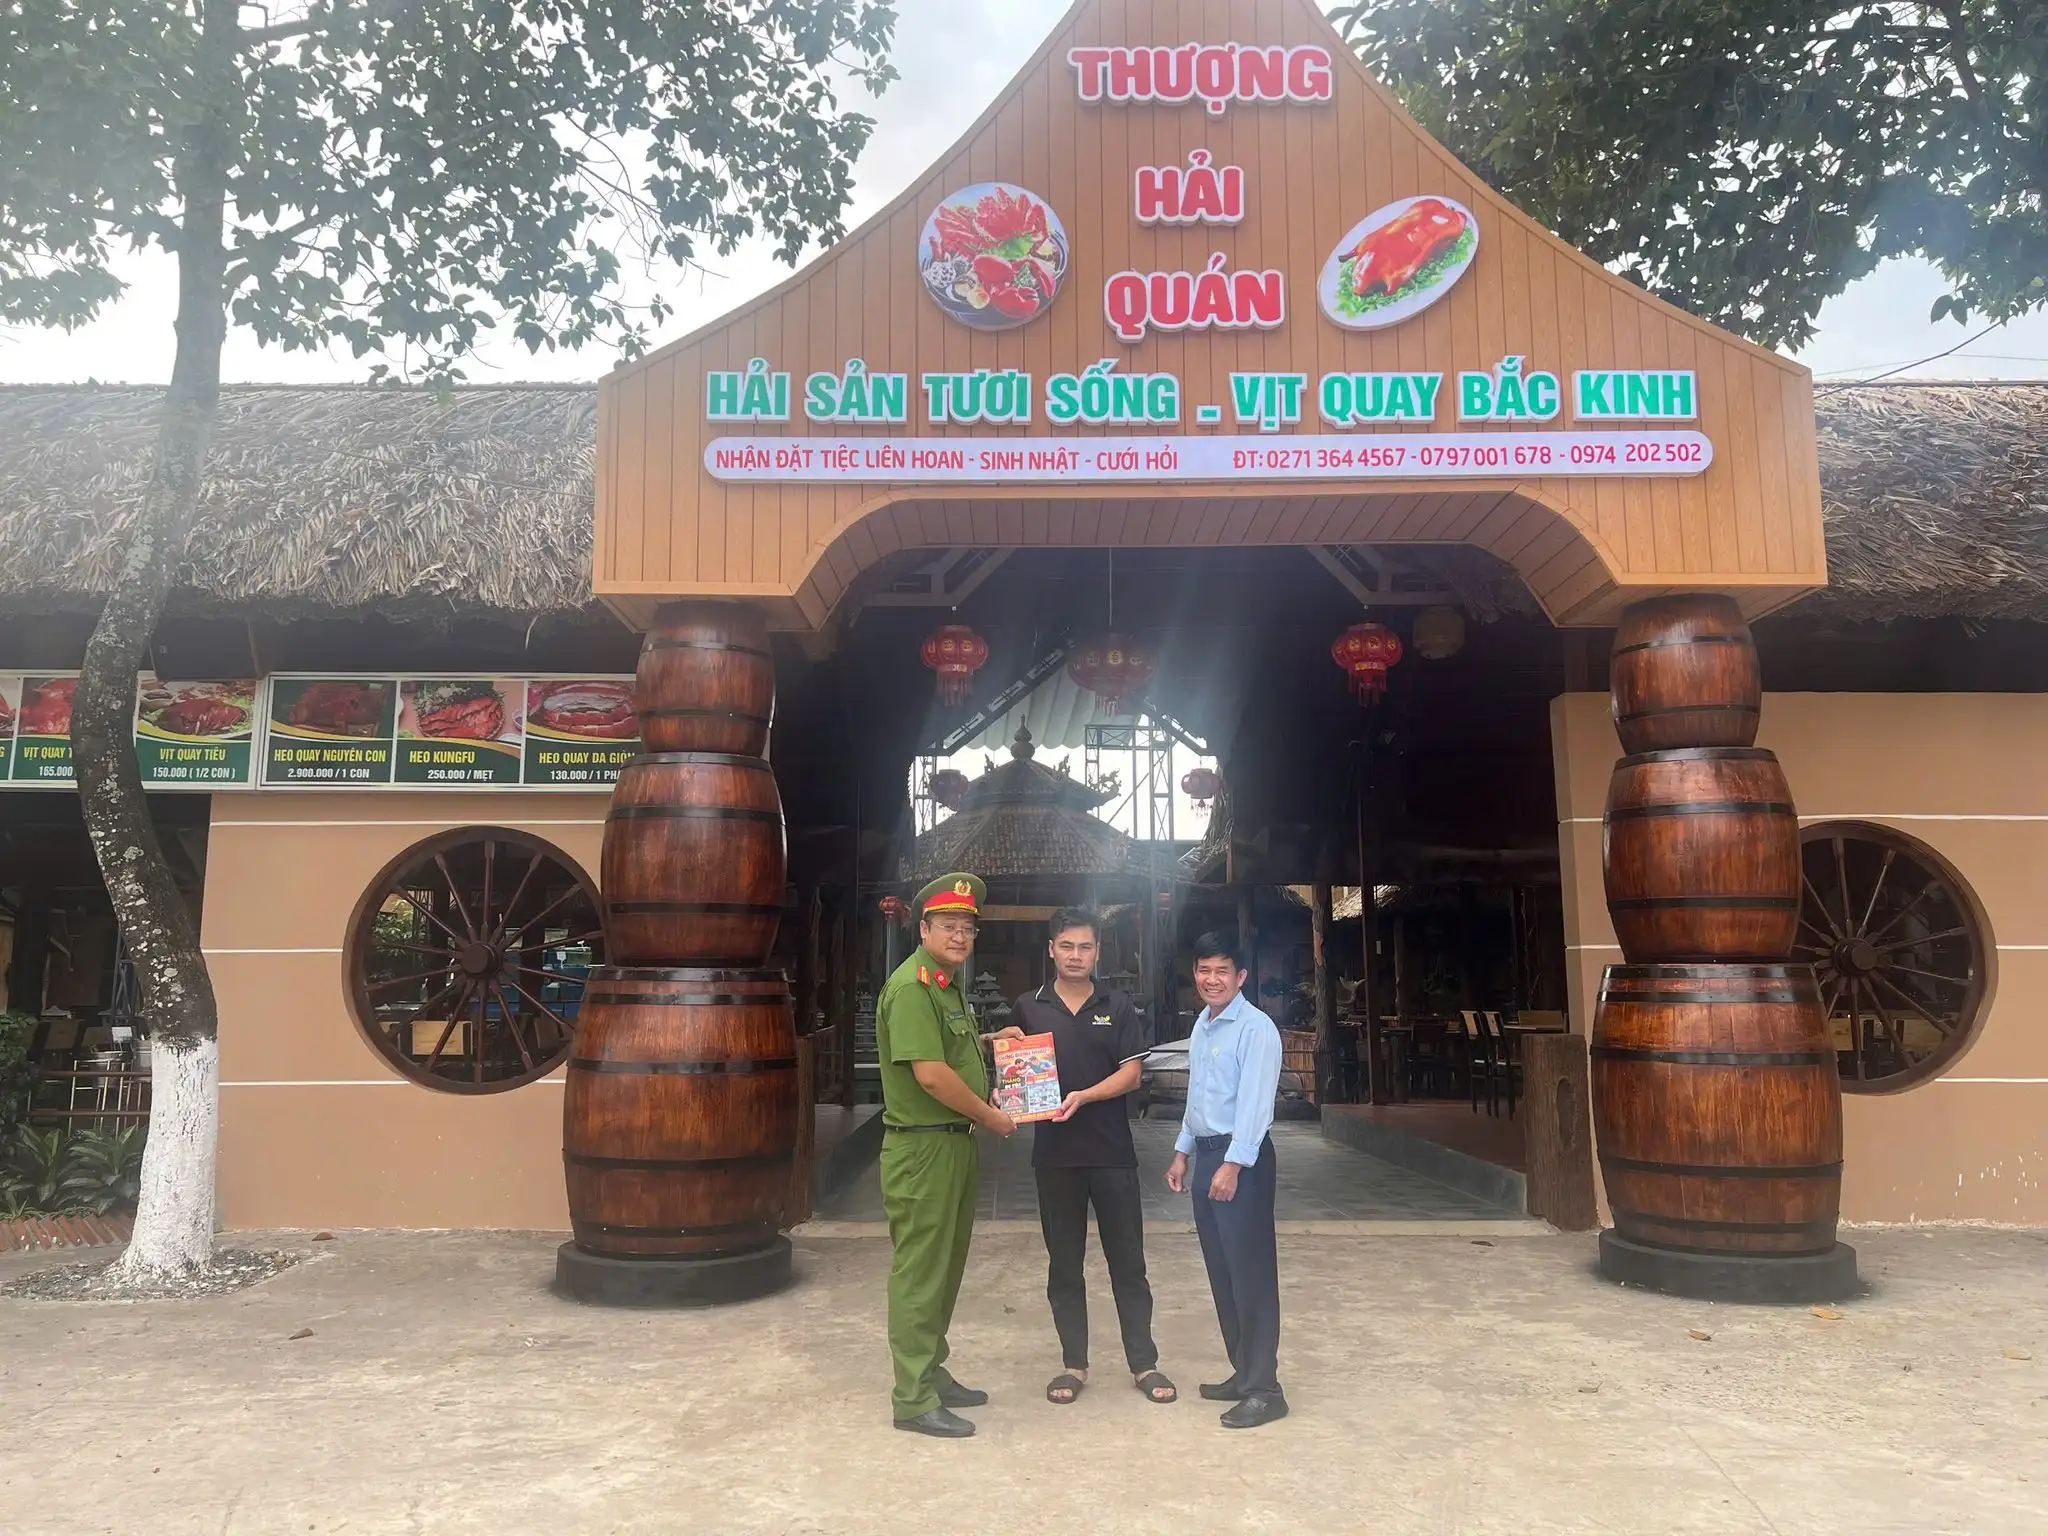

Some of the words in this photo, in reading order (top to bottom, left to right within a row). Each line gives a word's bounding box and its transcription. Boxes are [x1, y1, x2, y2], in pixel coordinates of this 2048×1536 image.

[1070, 45, 1331, 112] THƯỢNG
[1138, 151, 1241, 217] HẢI
[1107, 255, 1281, 335] QUÁN
[708, 359, 787, 415] HẢI
[807, 360, 904, 418] SẢN
[924, 370, 1028, 418] TƯƠI
[1050, 361, 1176, 418] SỐNG
[1232, 376, 1303, 427] VỊT
[1323, 376, 1440, 422] QUAY
[1462, 357, 1557, 416] BẮC
[1580, 373, 1692, 415] KINH
[716, 445, 770, 472] NHẬN
[775, 445, 813, 472] ĐẶT
[821, 445, 859, 472] TIỆC
[865, 446, 905, 468] LIÊN
[911, 451, 964, 468] HOAN
[980, 451, 1024, 470] SINH
[1028, 447, 1080, 474] NHẬT
[1096, 447, 1139, 470] CƯỚI
[1146, 446, 1178, 470] HỎI
[1318, 449, 1353, 468] 364
[1357, 447, 1406, 467] 4567
[1570, 444, 1617, 464] 0974
[24, 747, 39, 760] VỊT
[41, 747, 66, 759] QUAY
[160, 748, 175, 762] VỊT
[177, 748, 202, 761] QUAY
[274, 749, 293, 761] HEO
[296, 749, 321, 762] QUAY
[323, 747, 363, 761] NGUYÊN
[365, 750, 386, 762] CON
[409, 750, 430, 763] HEO
[433, 751, 475, 763] KUNGFU
[539, 752, 560, 763] HEO
[563, 752, 589, 764] QUAY
[39, 766, 73, 776] 165.000
[153, 767, 187, 778] 150.000
[288, 768, 333, 778] 2.900.000
[350, 768, 370, 778] CON
[427, 769, 465, 780] 250.000
[473, 770, 494, 781] MẸT
[550, 770, 587, 780] 130.000
